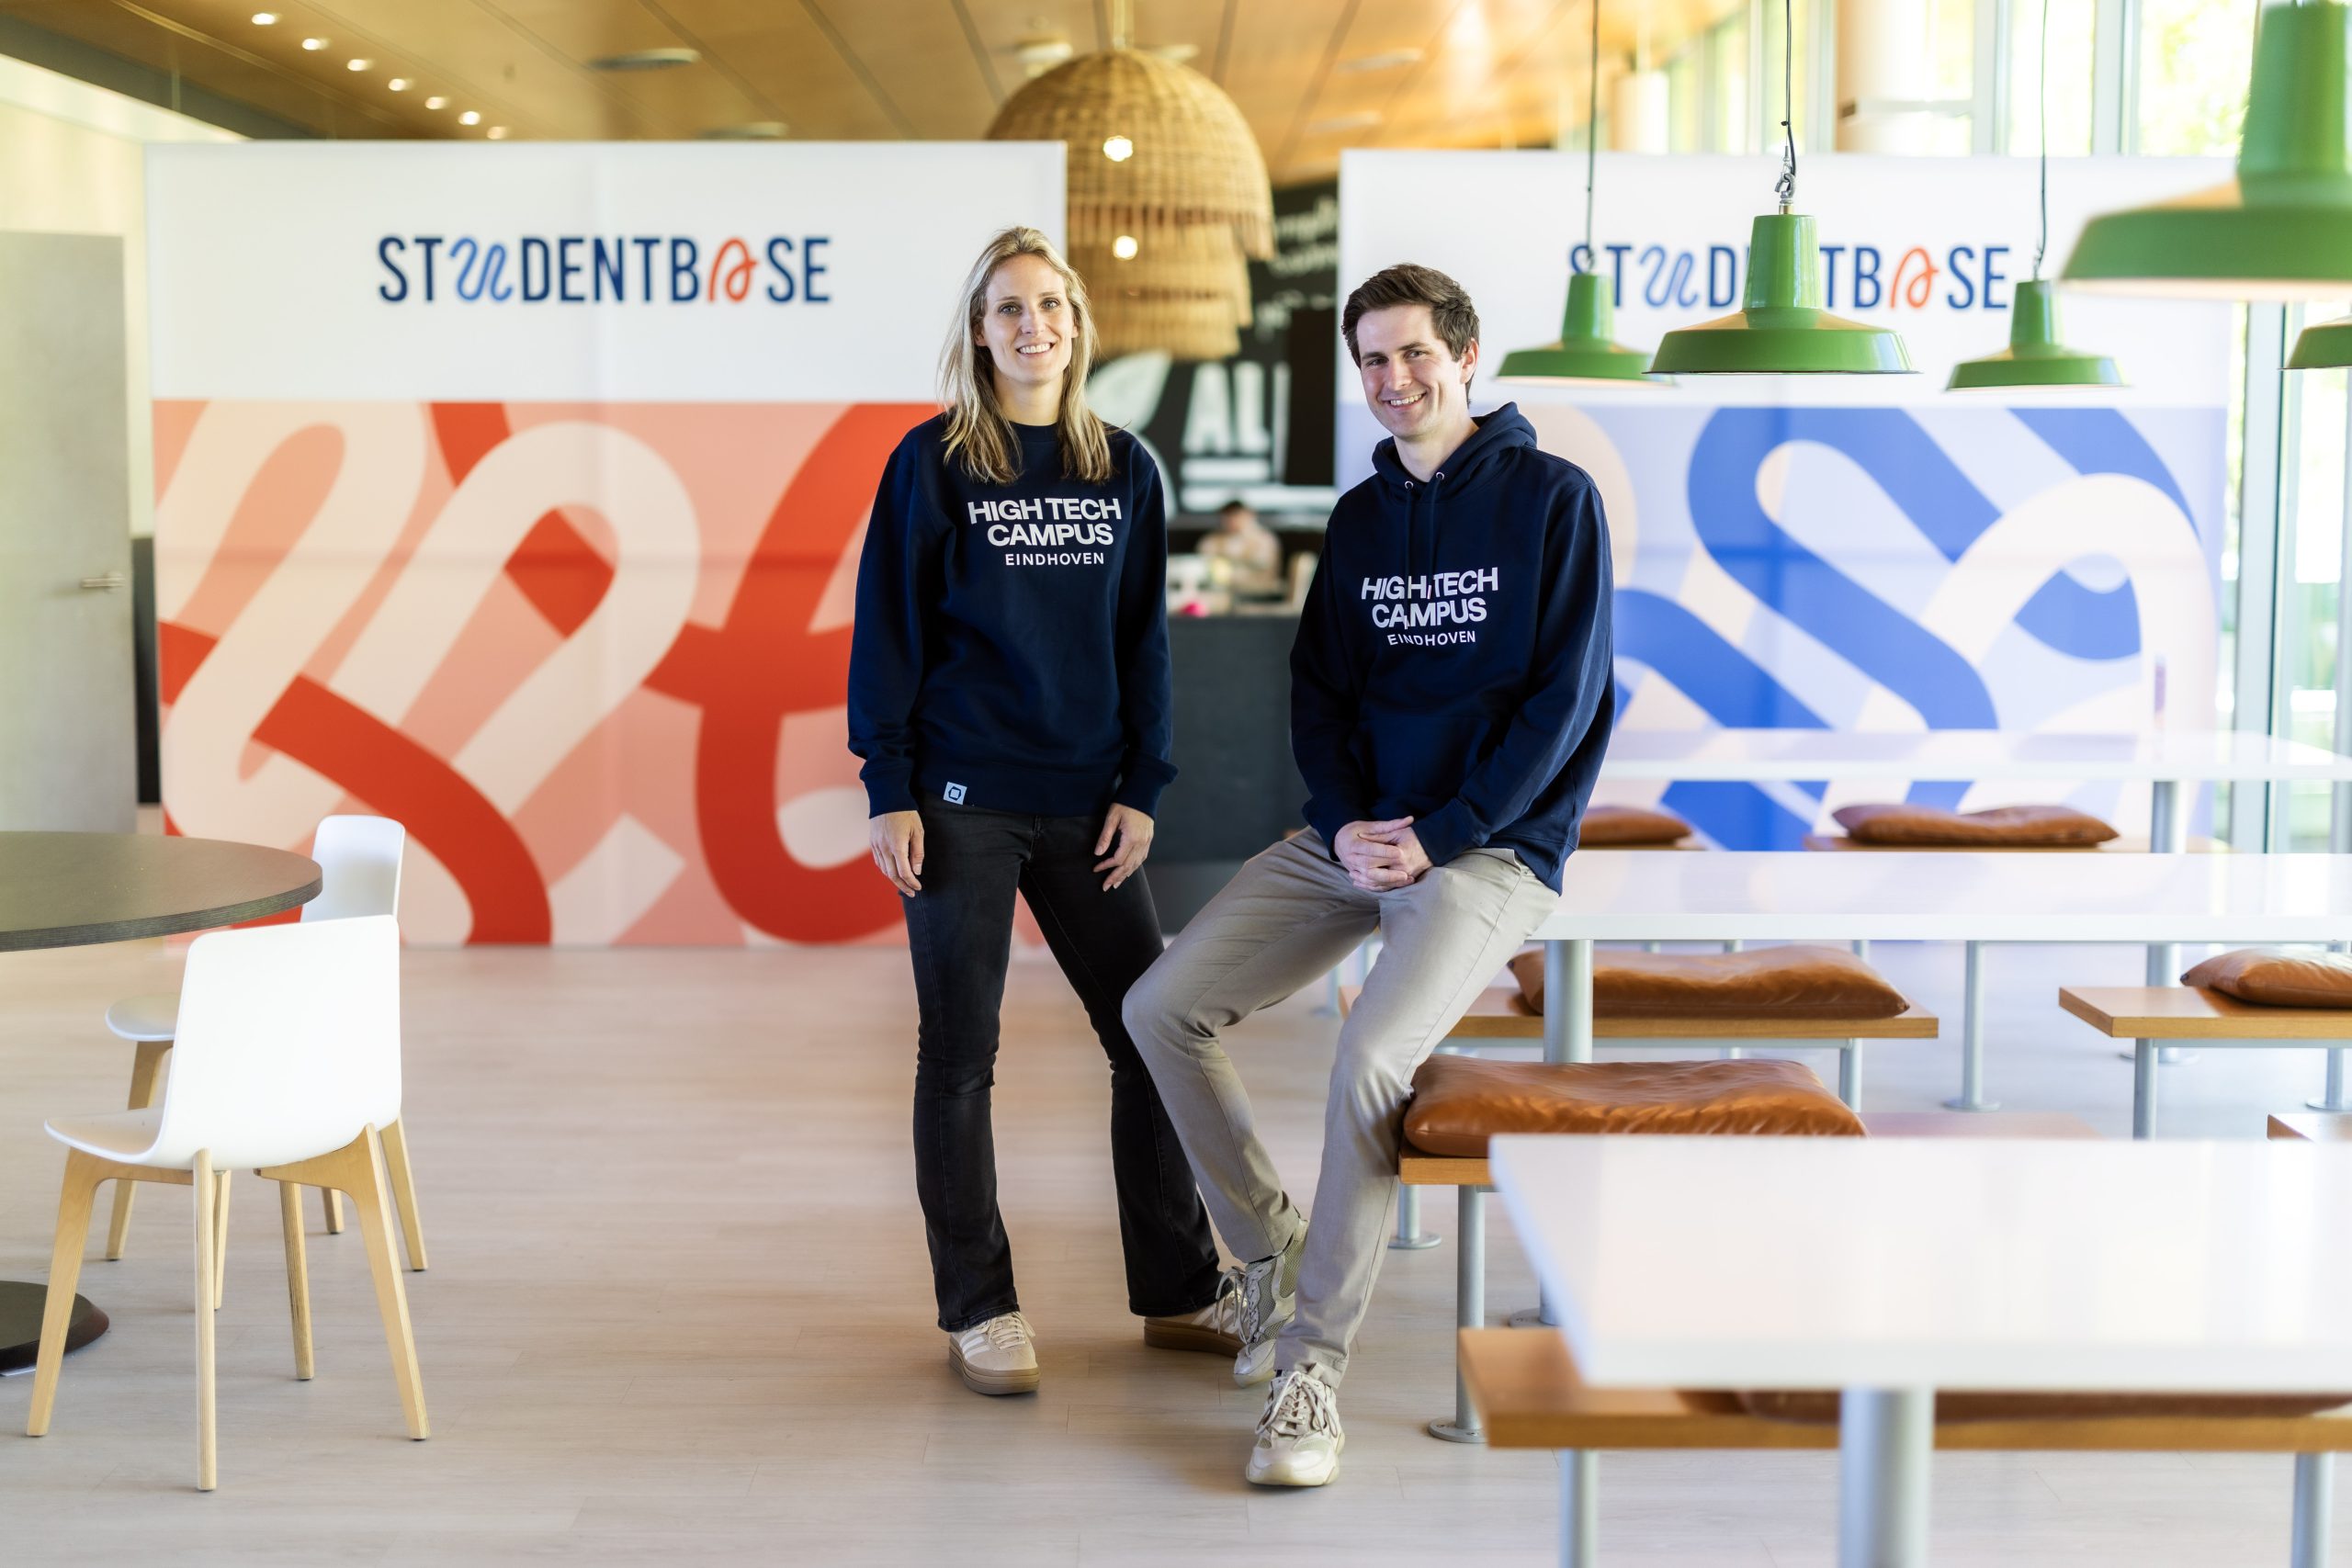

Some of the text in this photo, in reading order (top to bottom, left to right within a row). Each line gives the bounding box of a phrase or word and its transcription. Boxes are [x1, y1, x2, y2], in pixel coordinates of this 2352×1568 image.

[378, 236, 831, 302] STUDENTBASE
[967, 498, 1122, 525] HIGH TECH
[987, 524, 1114, 547] CAMPUS
[1005, 552, 1104, 566] EINDHOVEN
[1361, 567, 1498, 600] HIGH TECH
[1372, 597, 1487, 629] CAMPUS
[1386, 630, 1476, 646] EINDHOVEN
